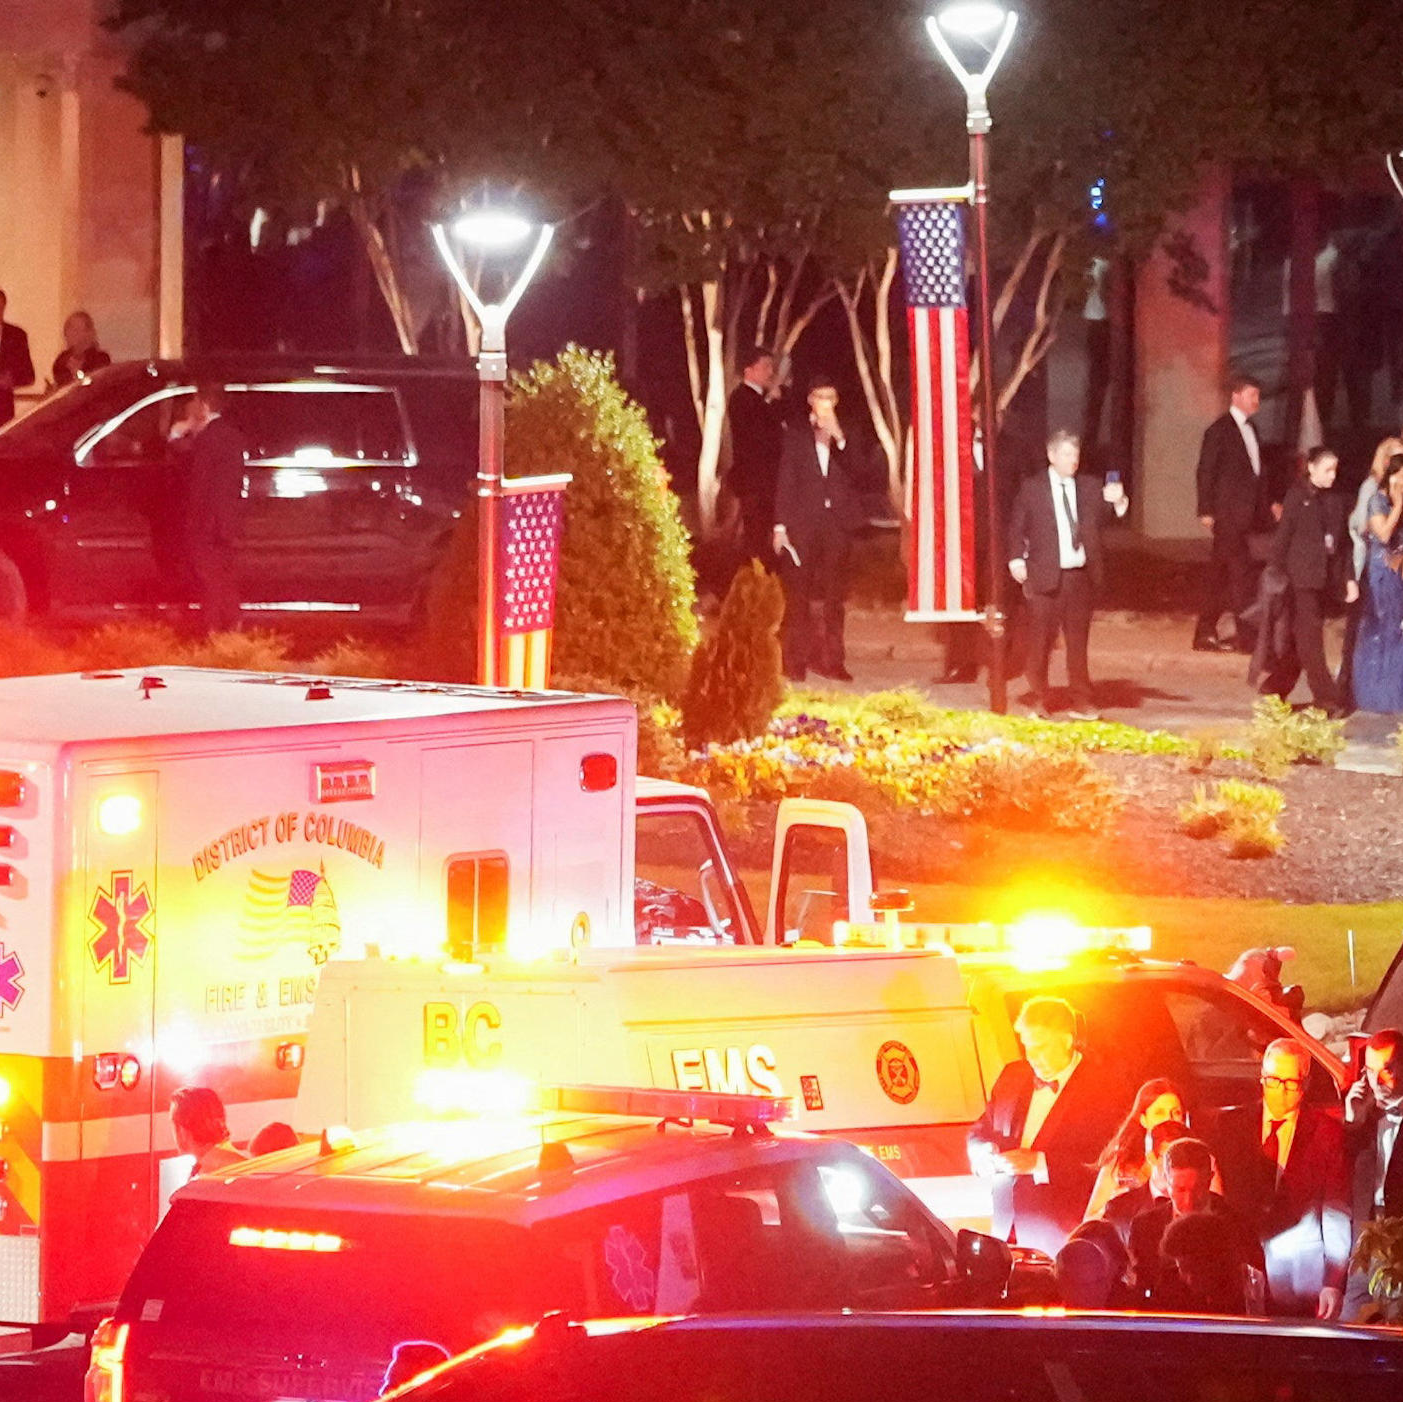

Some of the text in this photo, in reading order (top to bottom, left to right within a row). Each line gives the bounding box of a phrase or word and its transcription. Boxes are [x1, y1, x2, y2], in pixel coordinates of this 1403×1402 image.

[192, 812, 386, 882] DISTRICT OF COLUMBIA
[205, 981, 246, 1013] FIRE
[278, 975, 316, 1006] EMS
[423, 1001, 503, 1067] BC
[671, 1044, 784, 1098] EMS
[878, 1144, 902, 1160] EMS
